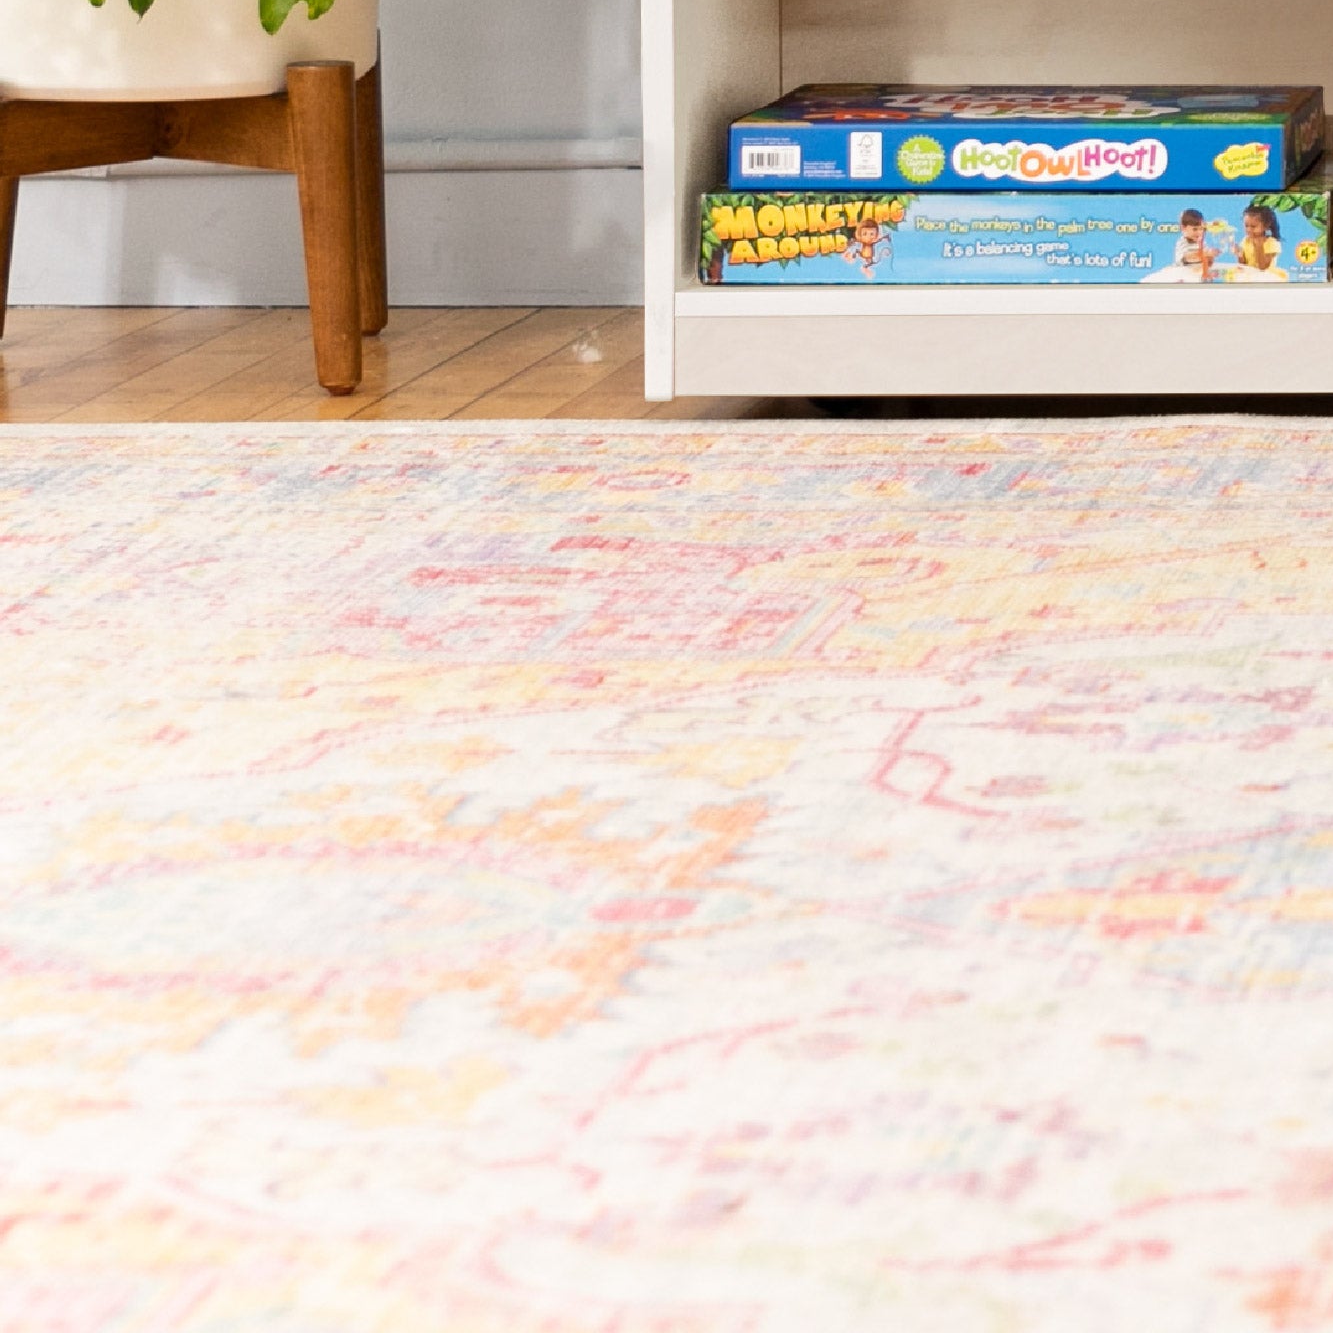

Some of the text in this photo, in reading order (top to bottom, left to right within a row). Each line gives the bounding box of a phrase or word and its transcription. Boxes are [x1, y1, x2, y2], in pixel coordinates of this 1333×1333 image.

[960, 144, 1022, 171] Hoot
[1084, 144, 1157, 175] Hoot!
[712, 200, 906, 239] MONKEYING
[949, 218, 969, 233] the
[971, 217, 1021, 233] monkeys
[1023, 222, 1033, 233] in
[1035, 216, 1055, 230] the
[1057, 220, 1086, 237] palm
[1087, 217, 1113, 230] tree
[1115, 221, 1137, 233] one
[1139, 216, 1154, 232] by
[728, 234, 849, 264] AROUND
[943, 241, 963, 257] It's
[975, 241, 1033, 256] balancing
[1036, 241, 1070, 254] game
[1046, 251, 1153, 268] that's lots of fun!
